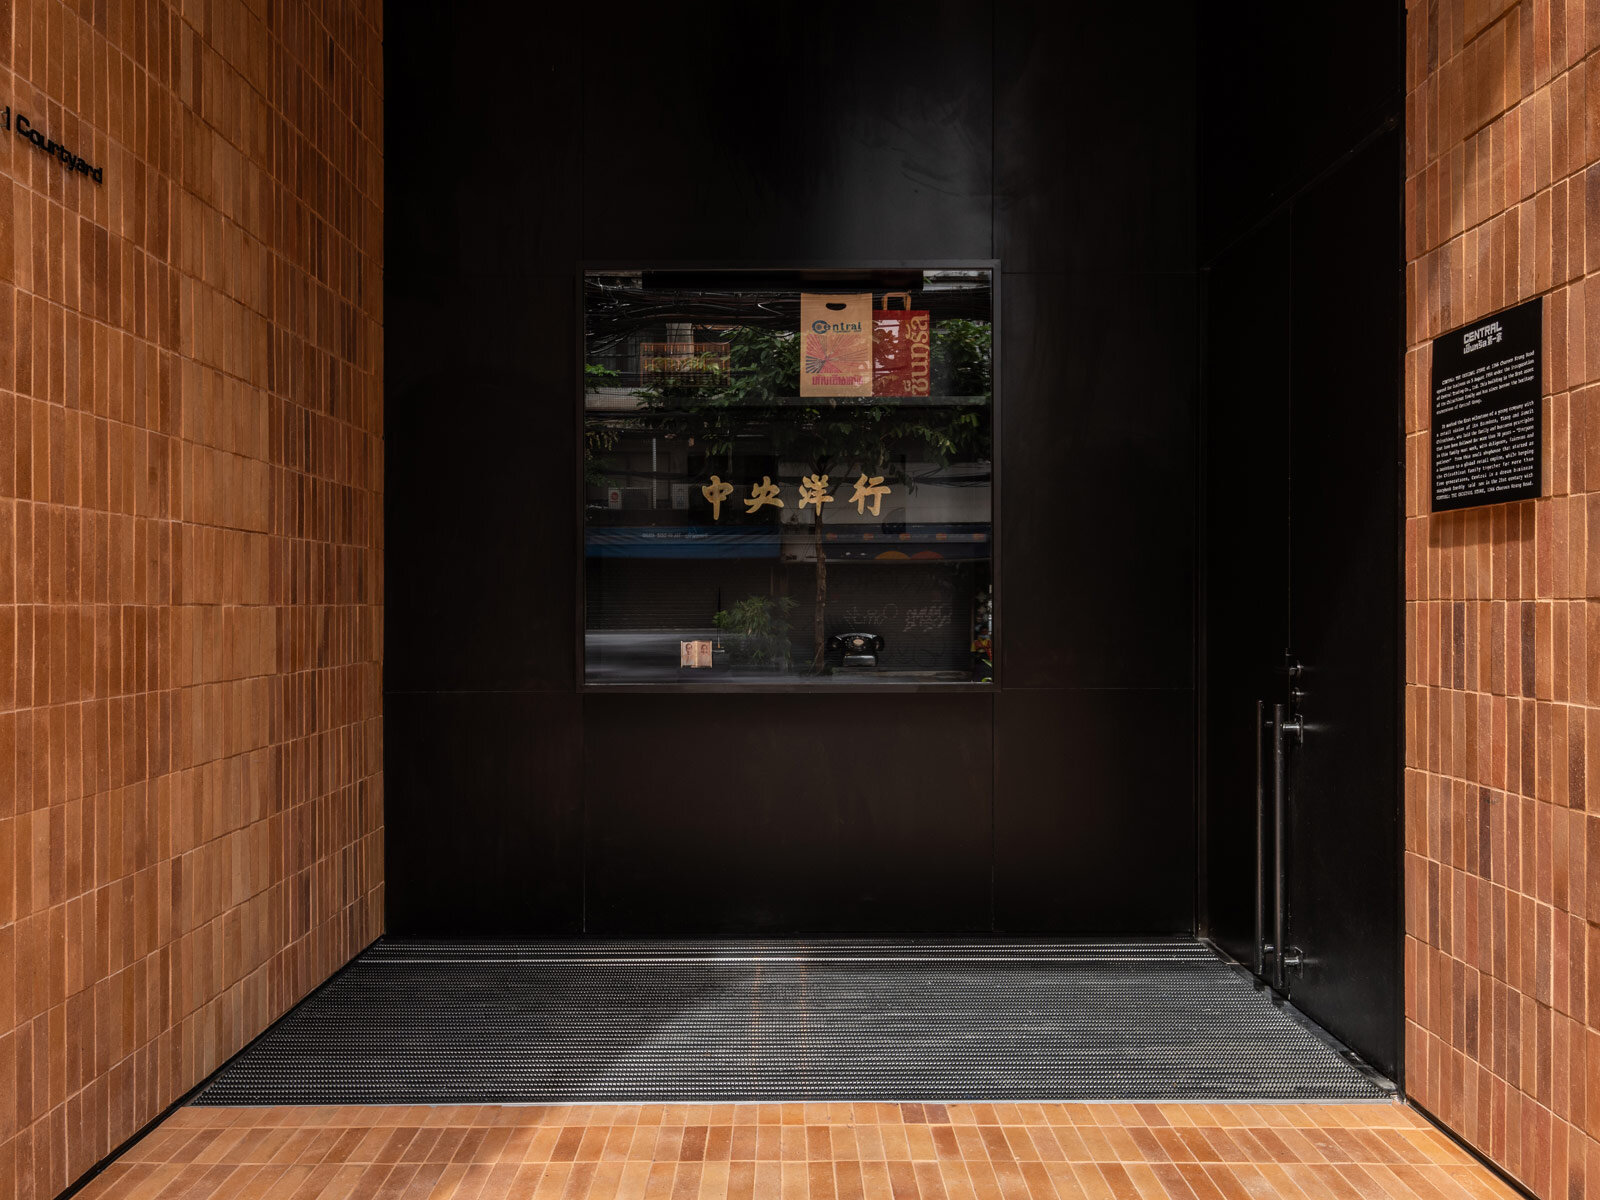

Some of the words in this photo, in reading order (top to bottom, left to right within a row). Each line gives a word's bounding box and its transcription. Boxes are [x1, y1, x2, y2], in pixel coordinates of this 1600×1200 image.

[16, 113, 103, 185] Courtyard
[811, 319, 862, 335] Central
[1464, 322, 1502, 344] CENTRAL
[701, 472, 892, 521] 中央洋行
